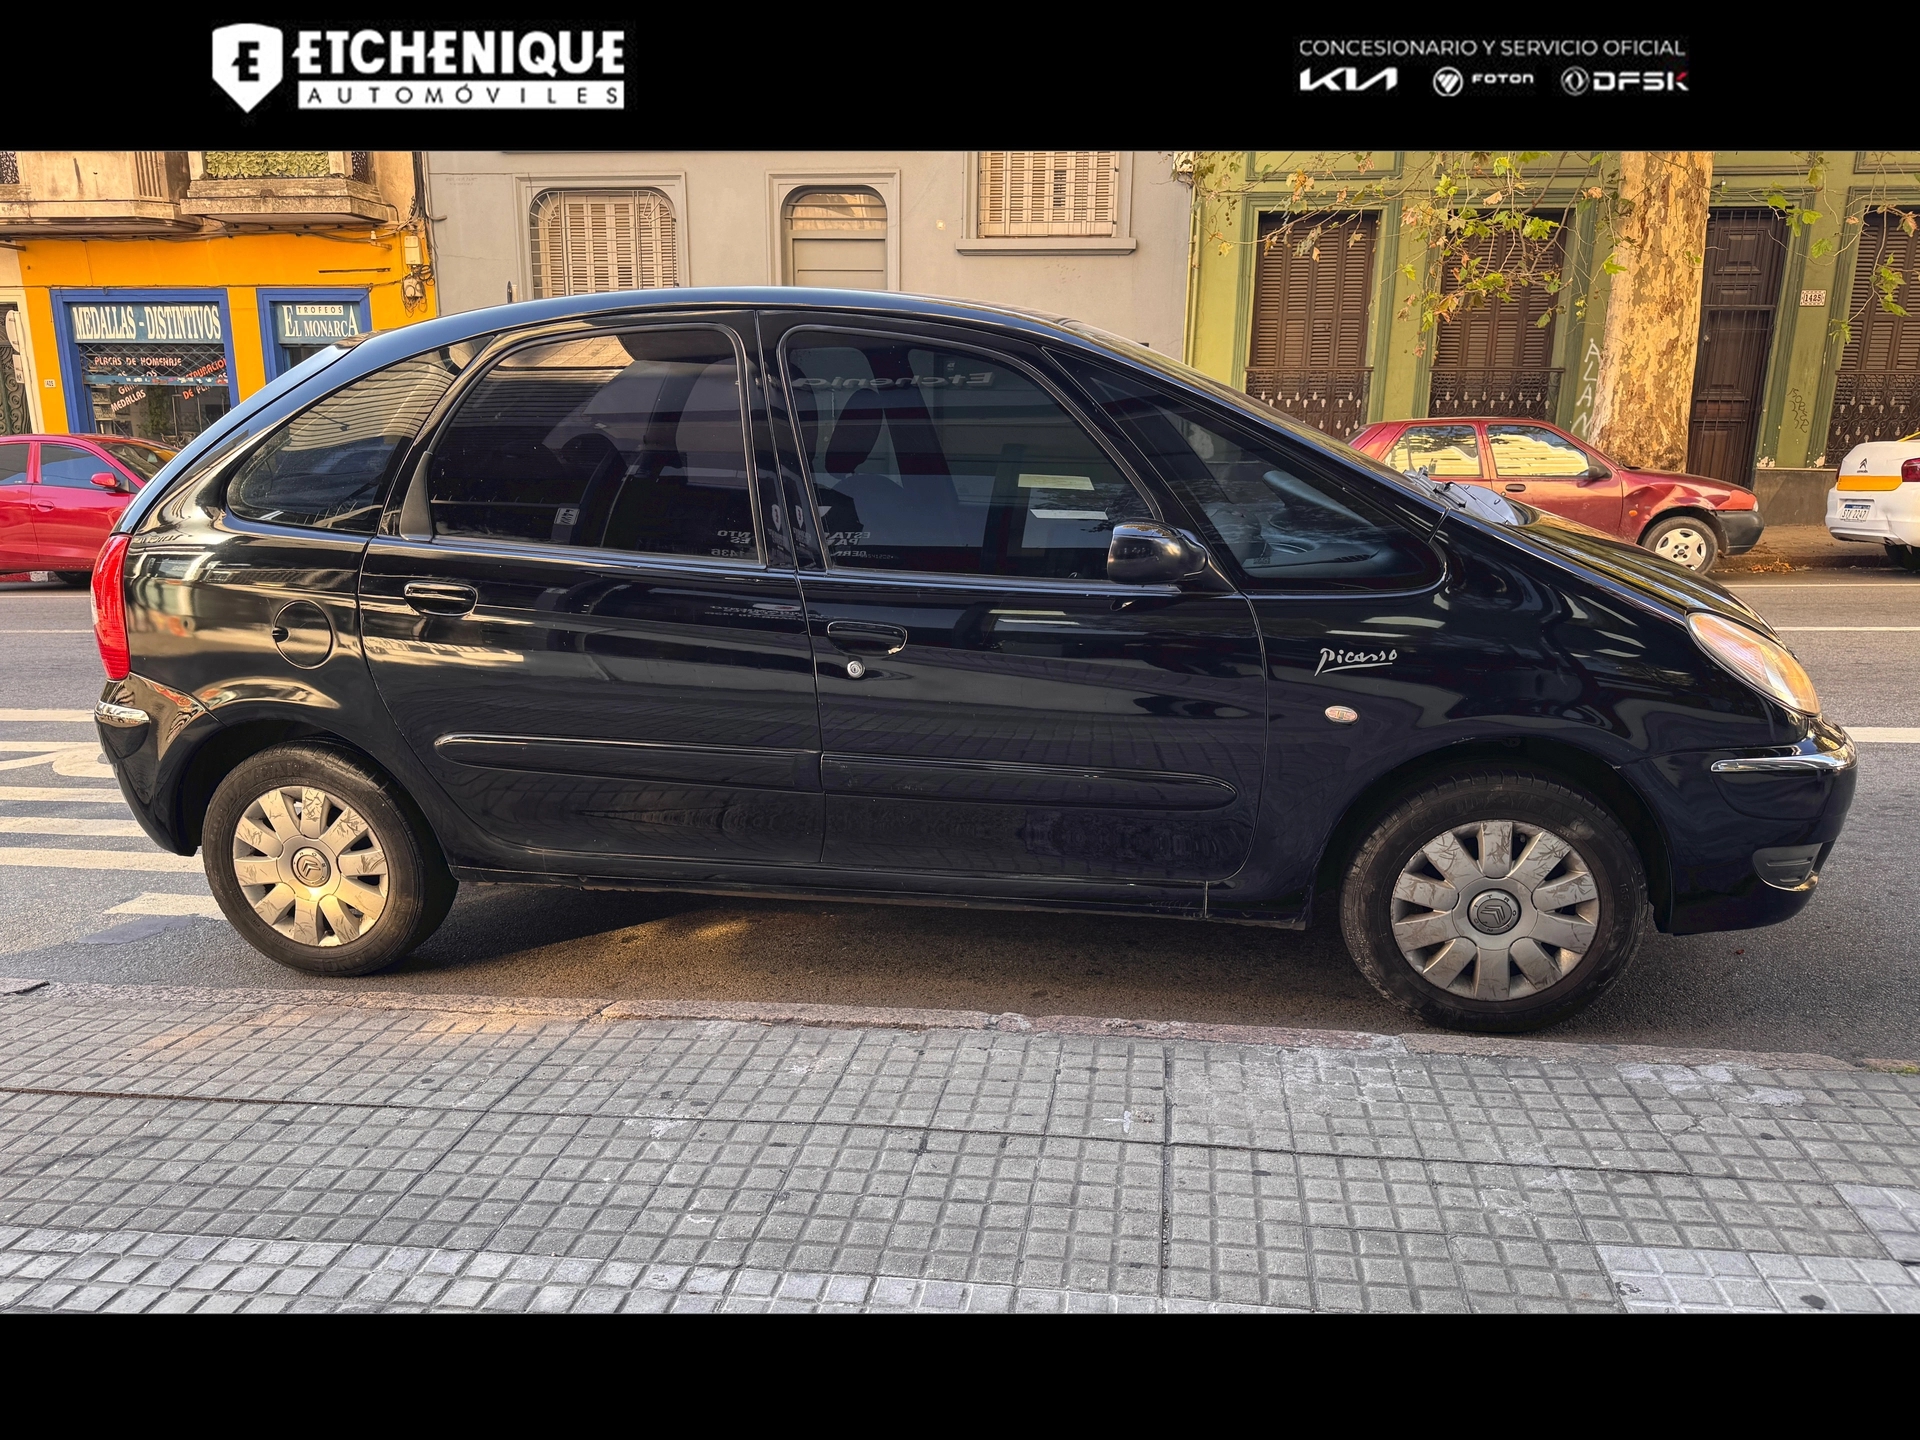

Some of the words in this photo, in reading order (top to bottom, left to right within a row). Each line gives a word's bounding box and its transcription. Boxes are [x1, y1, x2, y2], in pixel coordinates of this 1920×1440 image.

[1804, 294, 1822, 302] 1425
[297, 306, 343, 314] TROFEOS
[303, 304, 360, 337] MONARCA
[72, 305, 137, 339] MEDALLAS
[143, 305, 221, 340] DISTINTIVOS
[94, 356, 122, 366] PLACAS
[126, 357, 137, 366] DE
[140, 357, 182, 367] HOMENAJE
[182, 388, 195, 400] DE
[1570, 337, 1601, 437] ALAN
[110, 389, 147, 412] MEDALLAS
[1314, 647, 1398, 676] Picasso
